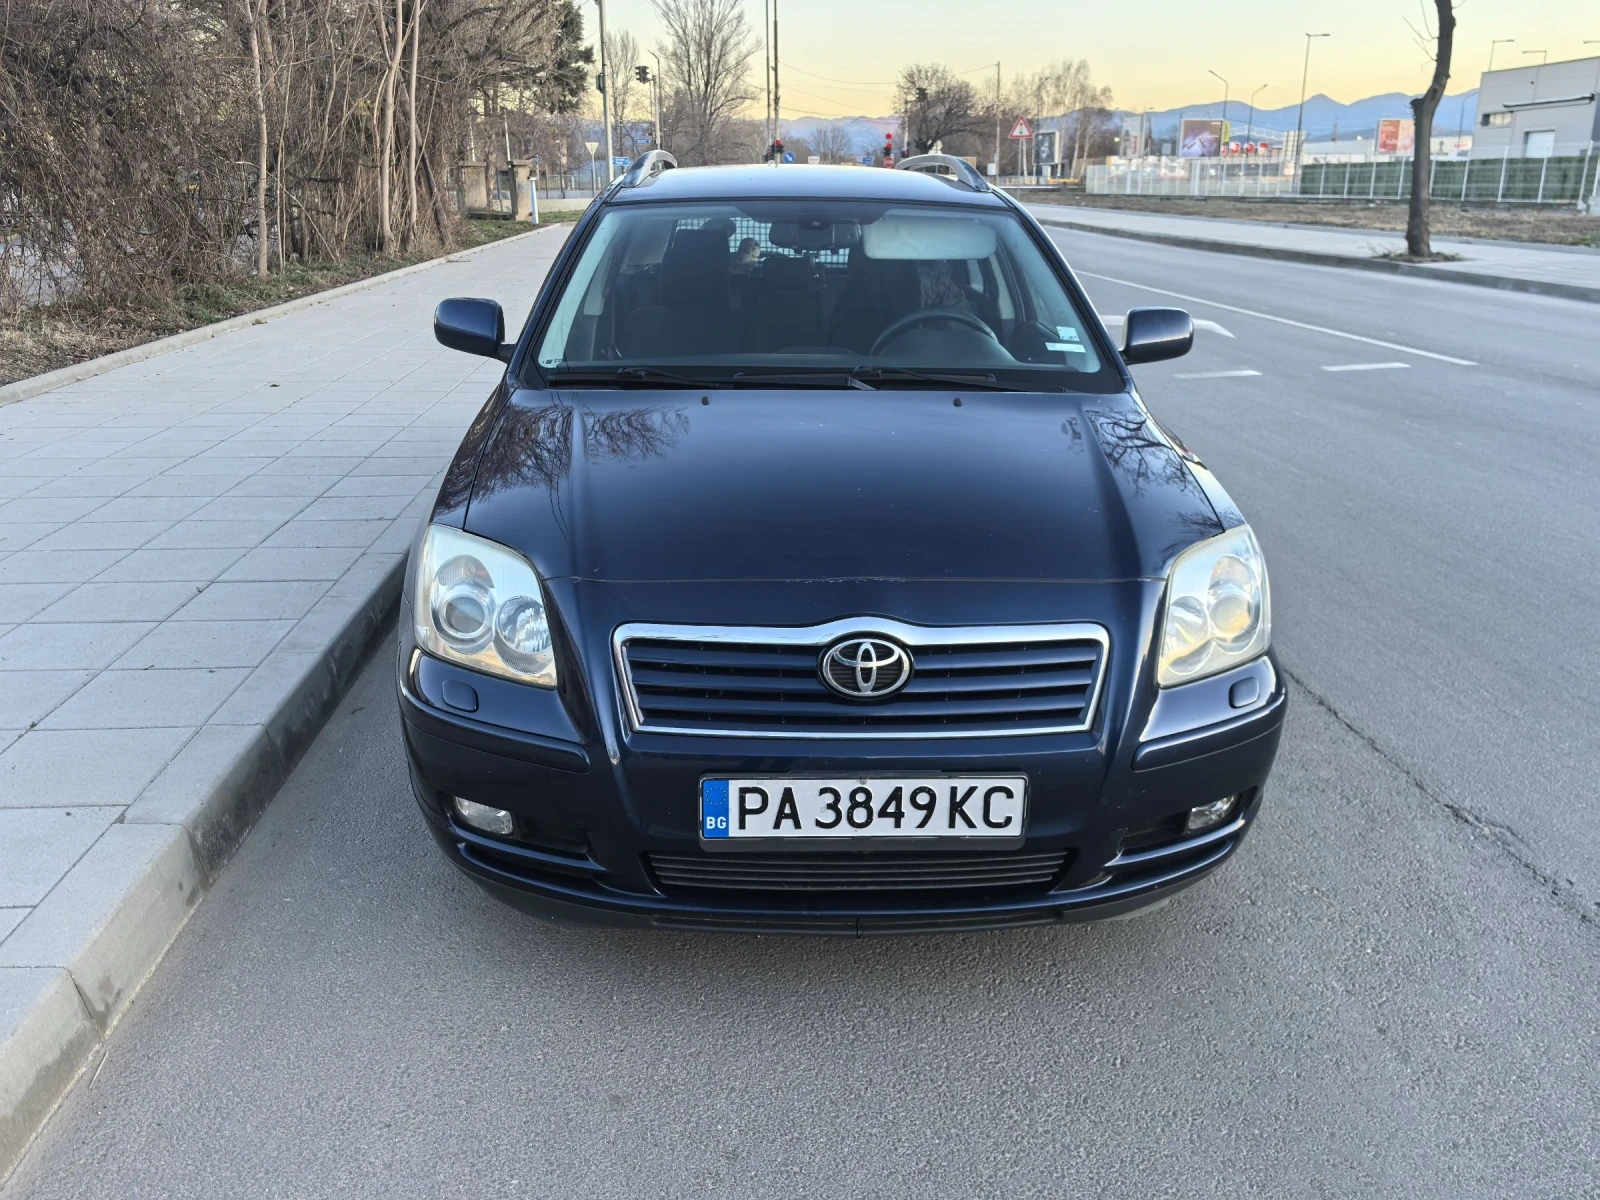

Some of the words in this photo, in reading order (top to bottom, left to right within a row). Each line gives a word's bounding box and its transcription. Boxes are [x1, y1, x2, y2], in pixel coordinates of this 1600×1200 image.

[738, 786, 802, 830] PA
[815, 785, 937, 830] 3849
[949, 785, 1015, 830] KC
[706, 816, 727, 829] BG
